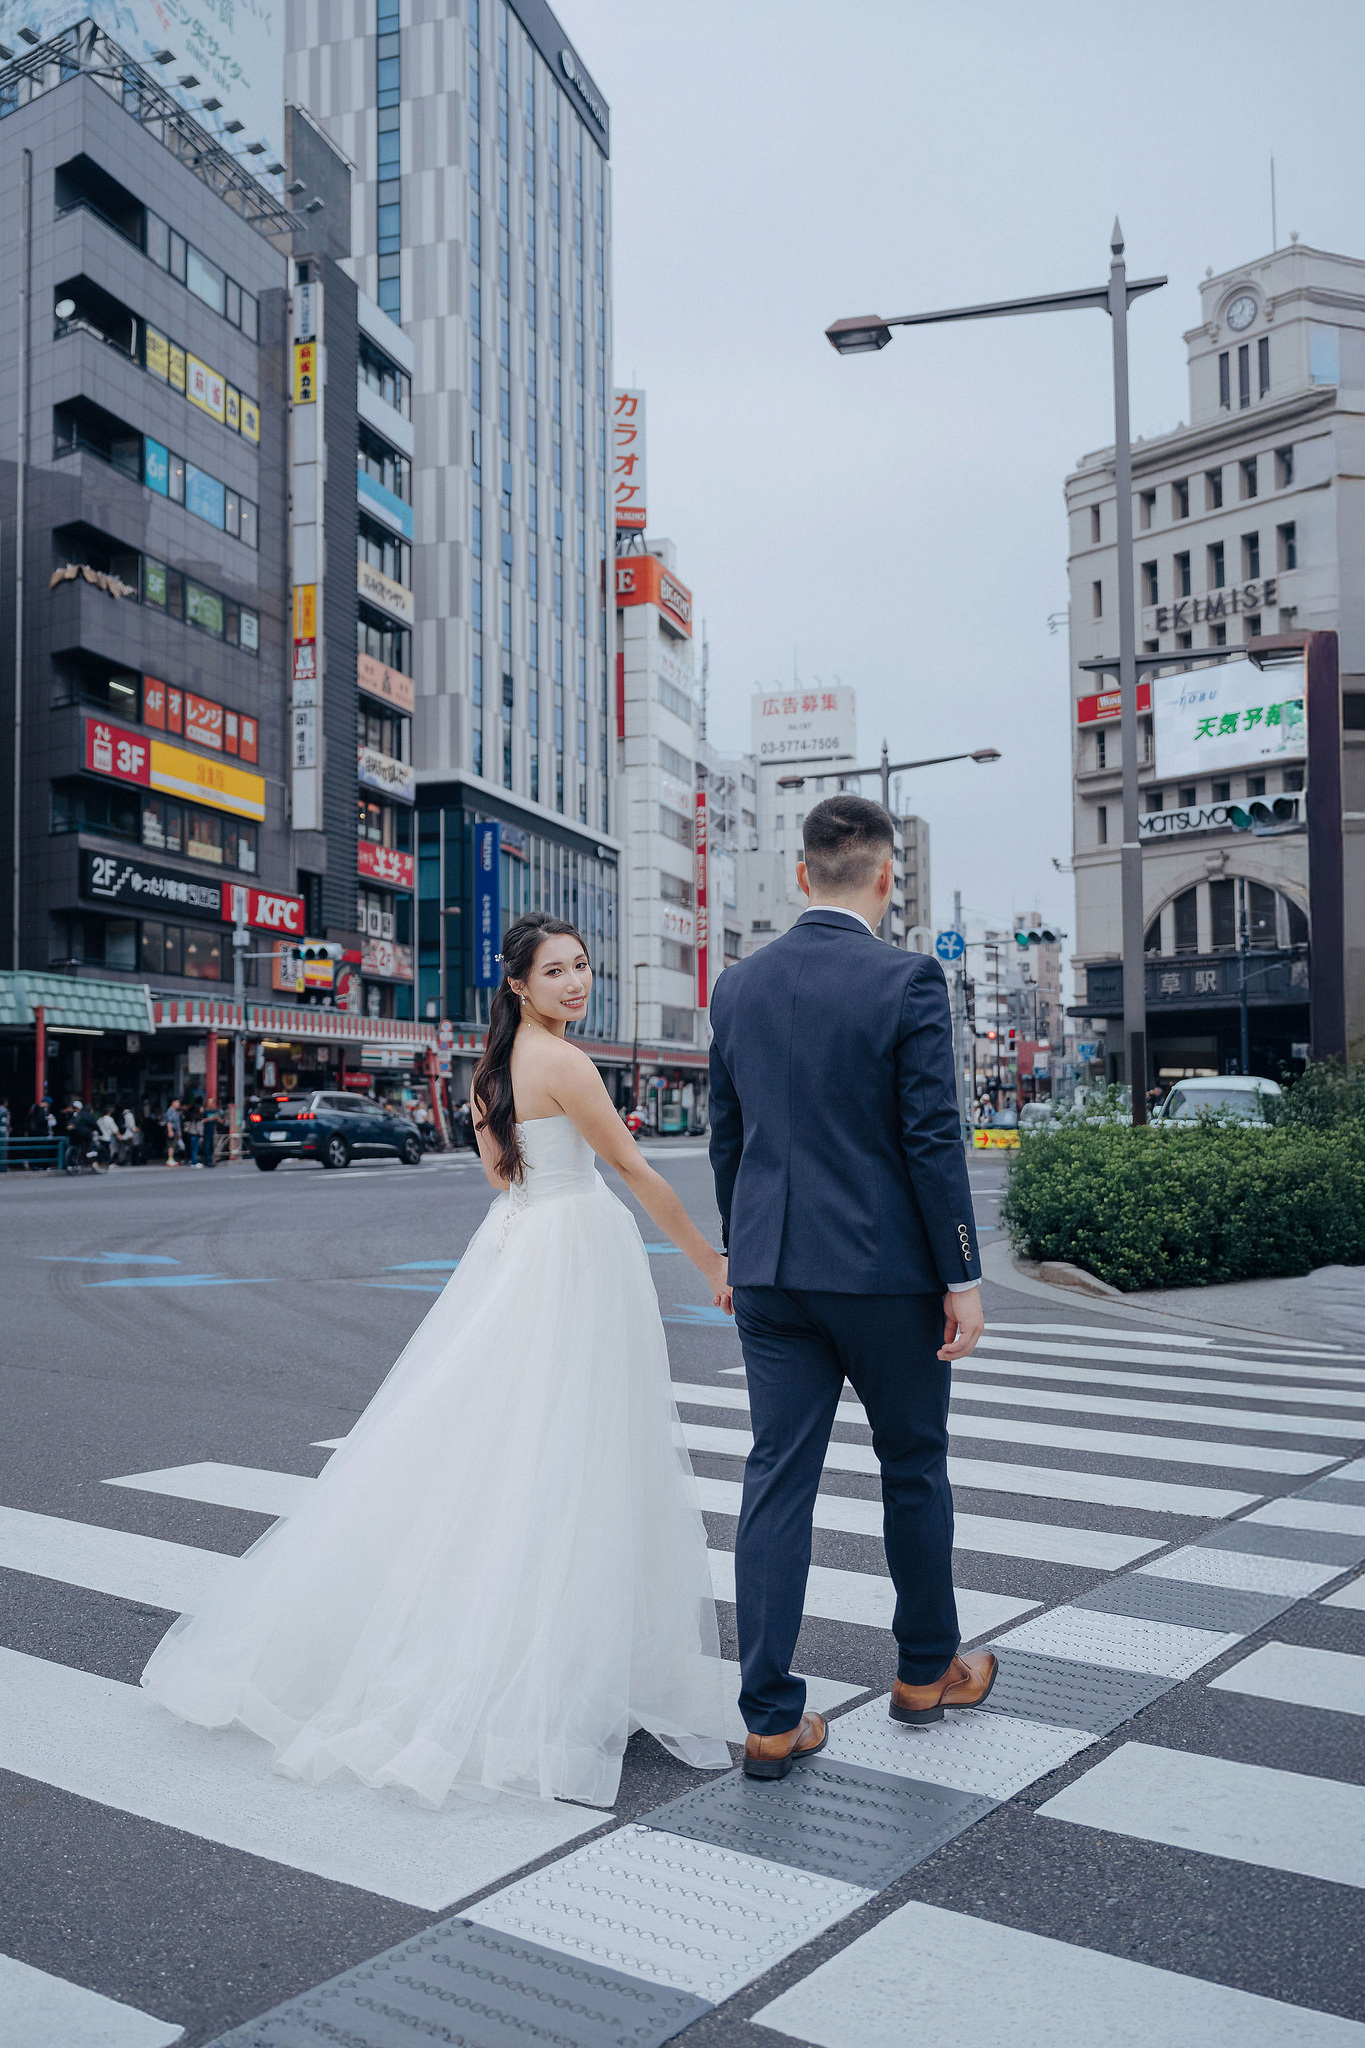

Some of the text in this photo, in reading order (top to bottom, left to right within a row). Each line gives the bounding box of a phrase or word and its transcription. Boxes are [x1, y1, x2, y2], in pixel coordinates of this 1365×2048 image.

[614, 393, 640, 504] カラオケ
[147, 452, 167, 482] 6F
[1155, 579, 1278, 632] EKIMISE
[146, 689, 163, 712] 4F
[762, 693, 838, 716] 広告募集
[1179, 688, 1218, 707] TOBU
[1194, 703, 1282, 741] 天気予報
[116, 740, 145, 775] 3F
[92, 857, 117, 887] 2F
[255, 894, 299, 930] KFC
[1144, 969, 1218, 995] 草駅
